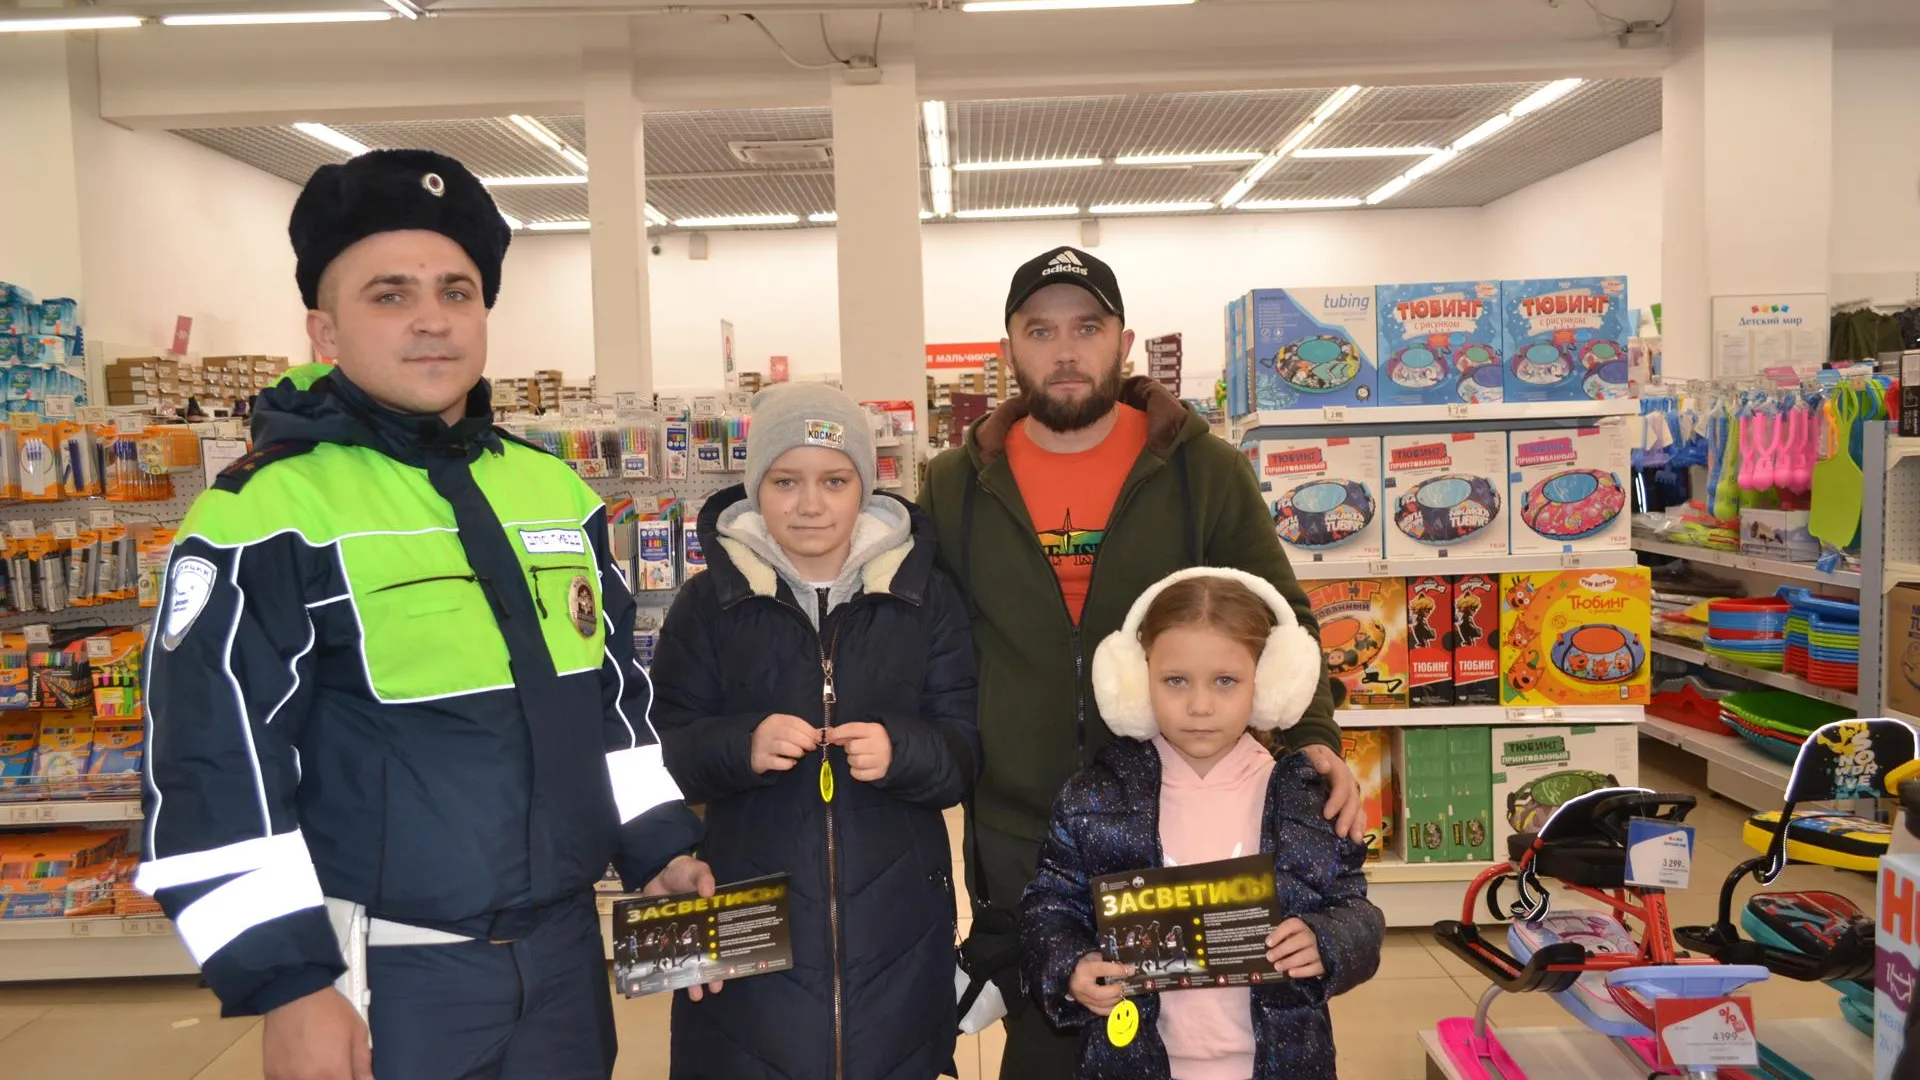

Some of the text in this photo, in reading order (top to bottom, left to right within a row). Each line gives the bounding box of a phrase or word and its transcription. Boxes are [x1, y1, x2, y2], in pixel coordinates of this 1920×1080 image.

[1042, 264, 1088, 276] adidas
[1324, 293, 1370, 310] tubing
[1522, 295, 1609, 316] ТЮБИНГ
[1397, 299, 1483, 320] ТЮБИНГ
[1739, 316, 1803, 326] Детский мир
[808, 429, 842, 443] КОСМОС
[1390, 457, 1450, 470] ПРИНТОВАННЫЙ
[1516, 452, 1576, 466] ПРИНТОВАННЫЙ
[1265, 461, 1326, 475] ПРИНТОВАННЫЙ
[1566, 595, 1630, 611] Тюбинг
[1413, 661, 1449, 672] ТЮБИНГ
[1459, 659, 1495, 671] ТЮБИНГ
[1508, 740, 1558, 752] ТЮБИНГ
[1501, 750, 1568, 763] ПРИНТОВАННЫЙ
